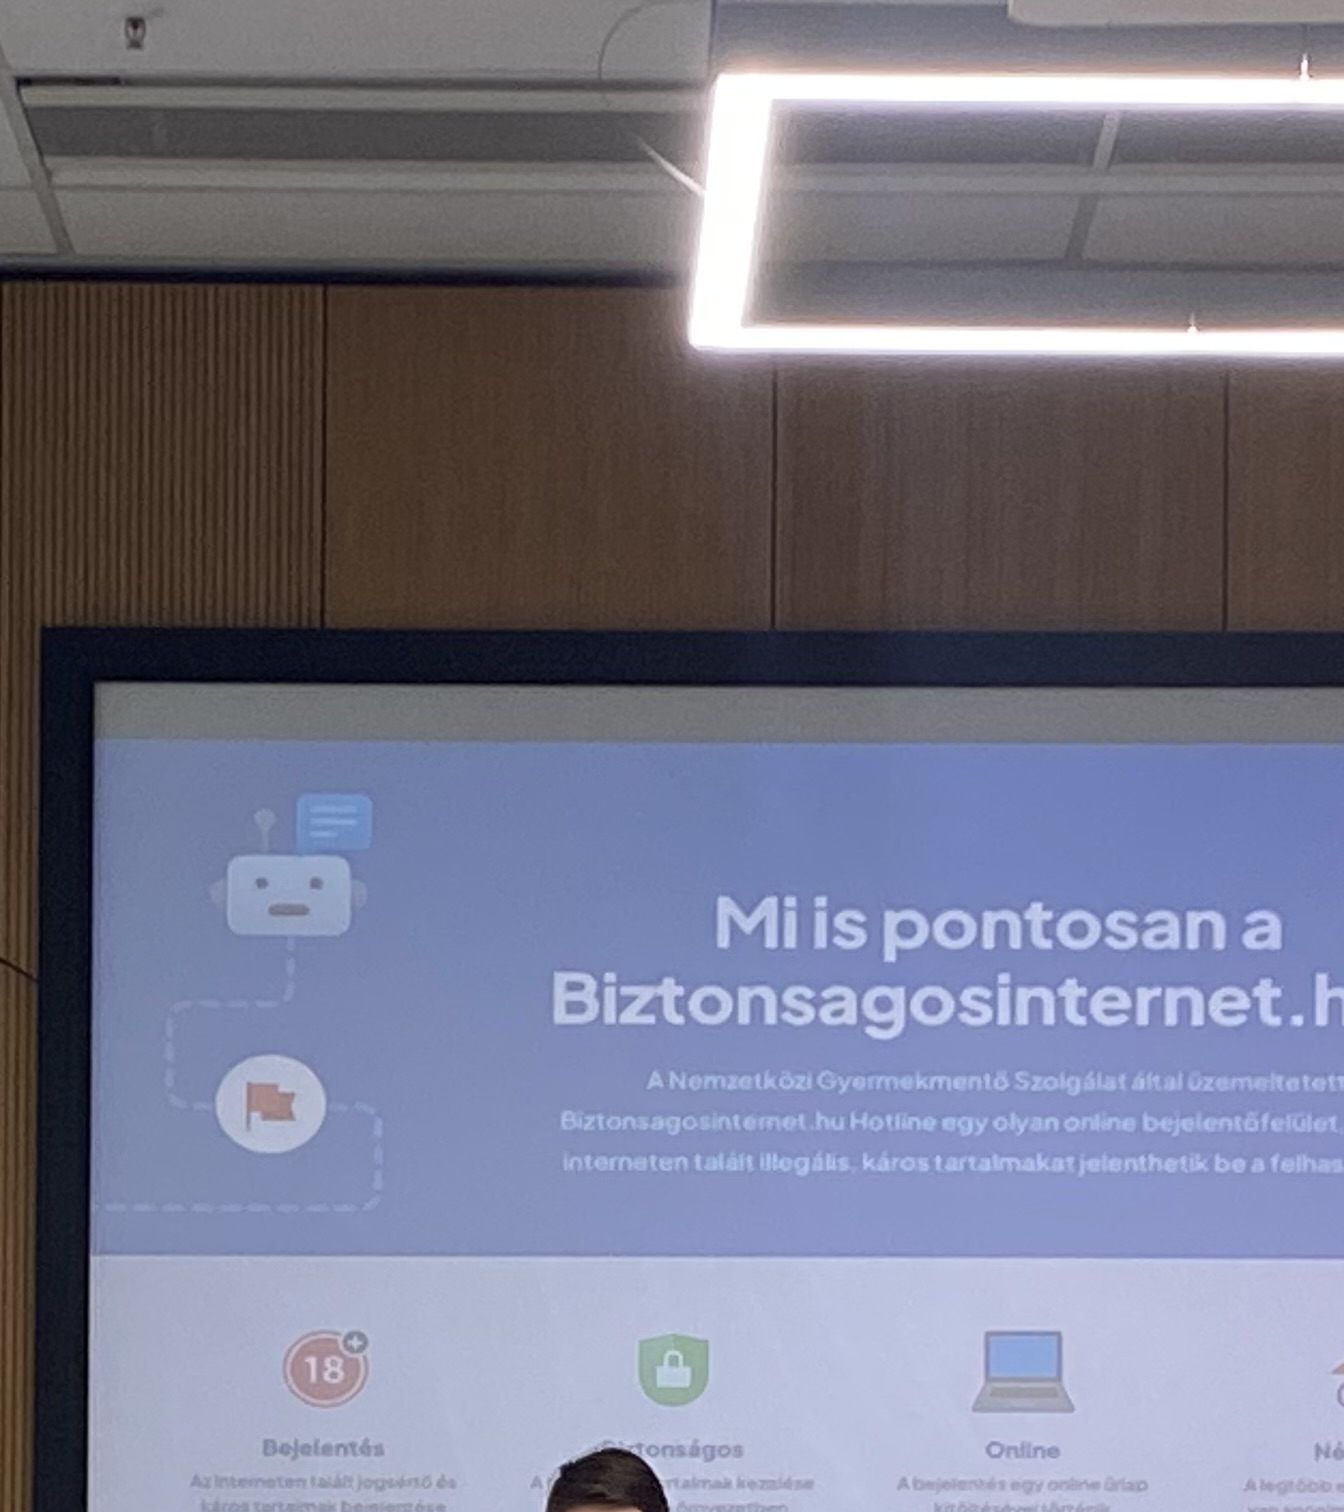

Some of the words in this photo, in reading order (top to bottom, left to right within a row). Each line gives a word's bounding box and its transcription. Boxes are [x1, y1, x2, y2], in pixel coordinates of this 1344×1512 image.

[716, 895, 797, 951] Mi
[813, 895, 867, 951] is
[883, 899, 1226, 963] pontosan
[1241, 906, 1284, 951] a
[646, 1071, 664, 1090] A
[850, 1111, 936, 1132] Hotline
[942, 1116, 988, 1137] egy
[992, 1112, 1058, 1137] olyan
[1063, 1112, 1136, 1133] online
[563, 1151, 688, 1173] interneten
[862, 1152, 929, 1173] káros
[933, 1153, 1074, 1174] tartalmakat
[1077, 1152, 1210, 1177] jelenthetik
[1214, 1153, 1246, 1174] be
[1250, 1158, 1265, 1174] a
[262, 1437, 386, 1462] Bejelentés
[984, 1440, 1061, 1460] Online
